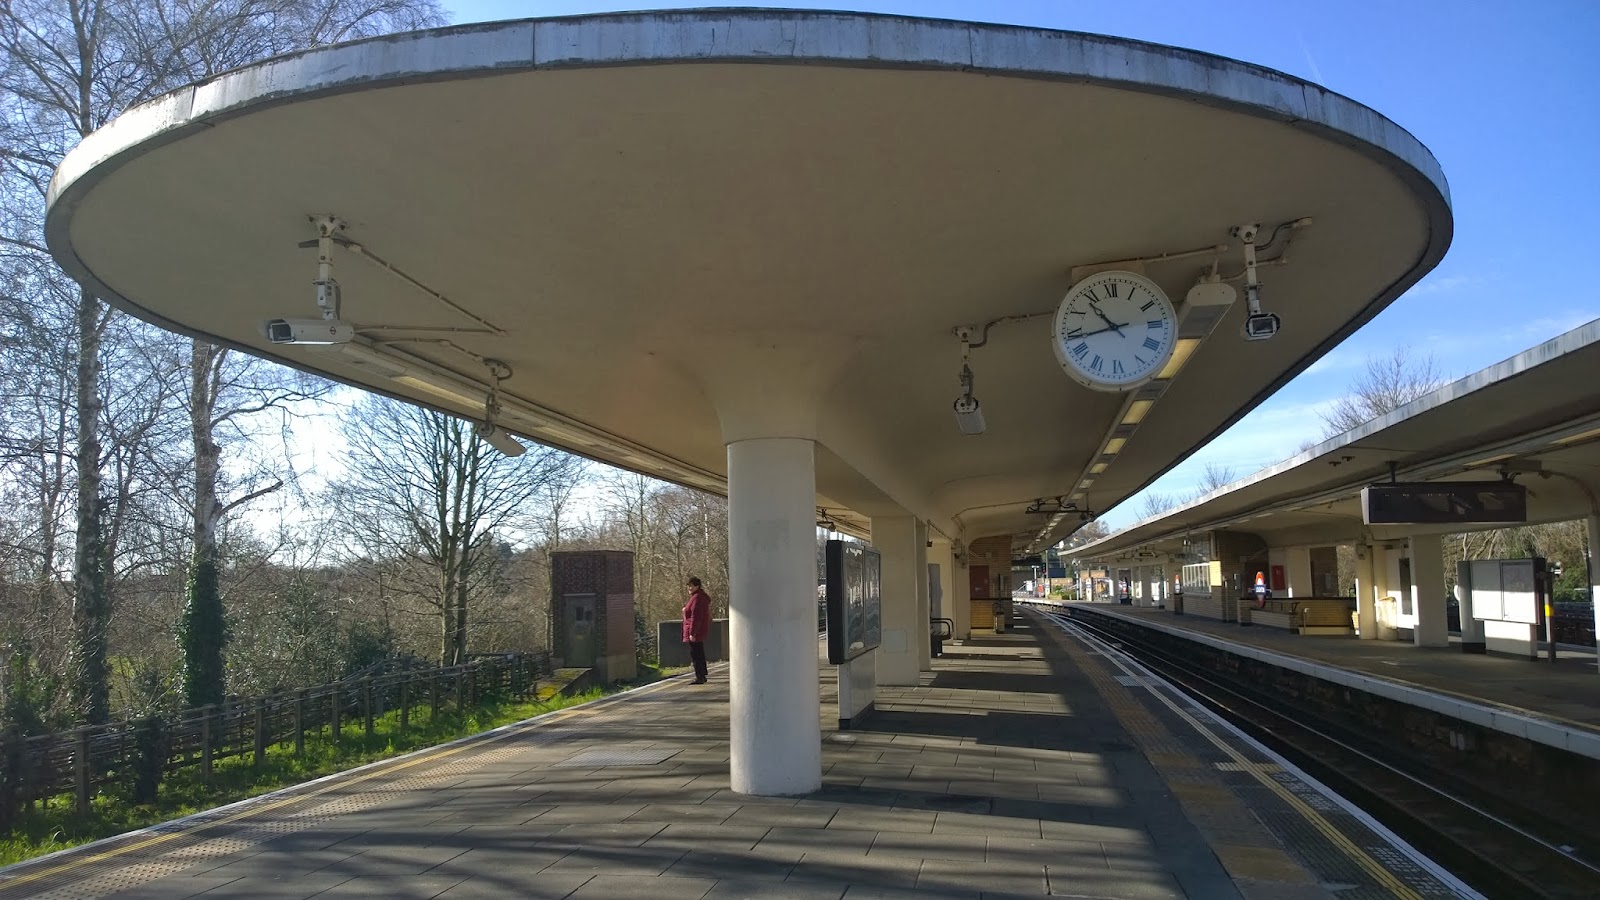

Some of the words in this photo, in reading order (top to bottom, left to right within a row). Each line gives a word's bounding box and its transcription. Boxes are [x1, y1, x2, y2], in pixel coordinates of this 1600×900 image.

[1083, 289, 1099, 304] XI
[1104, 284, 1118, 298] XII
[1126, 288, 1136, 300] I
[1140, 300, 1154, 312] II
[1070, 308, 1086, 320] X
[1148, 320, 1162, 328] III
[1073, 342, 1089, 360] VIII
[1143, 337, 1160, 351] IIII
[1090, 354, 1103, 372] VII
[1113, 360, 1125, 374] VI
[1134, 354, 1145, 368] V
